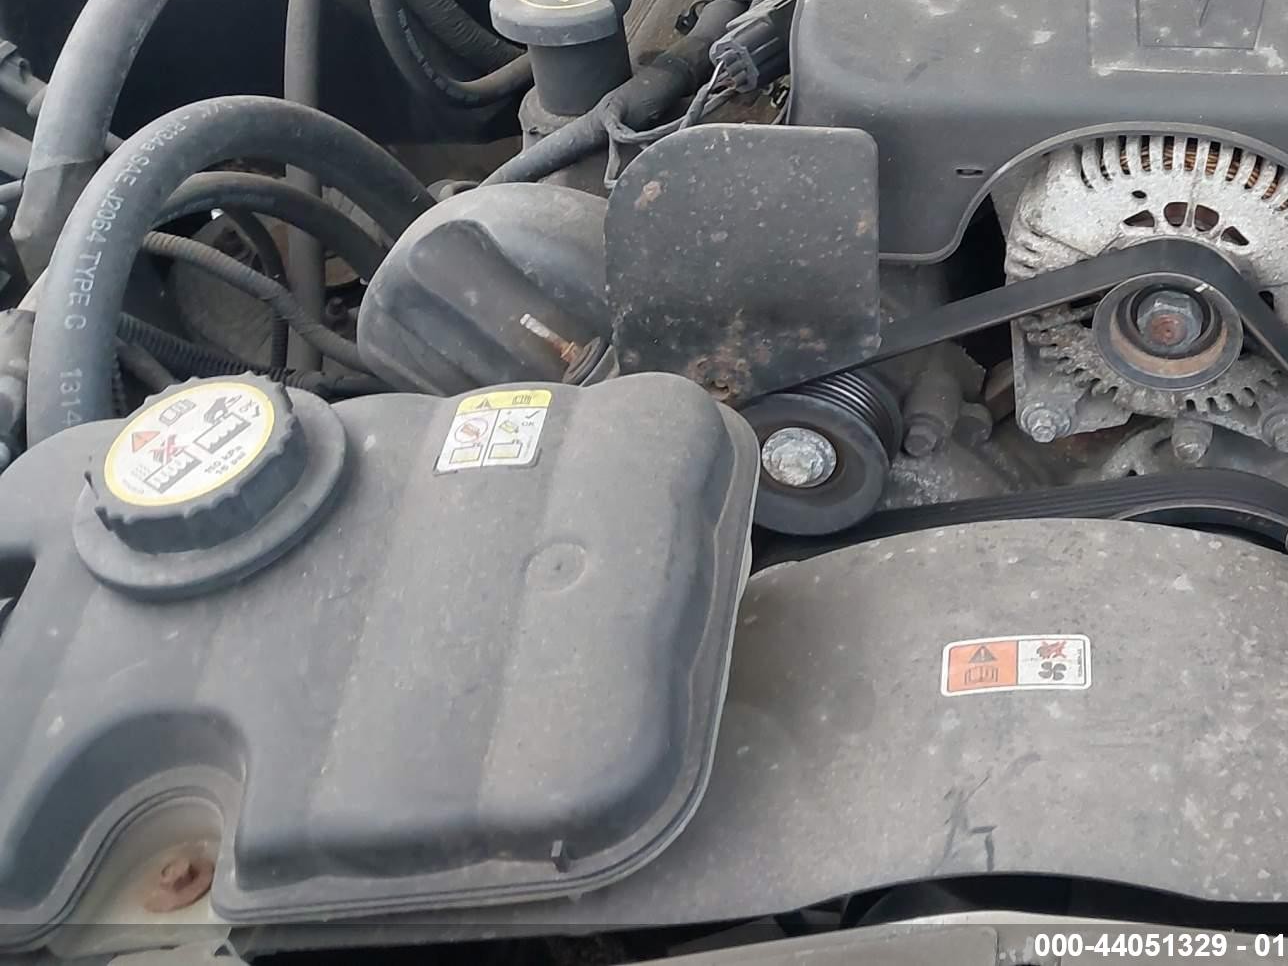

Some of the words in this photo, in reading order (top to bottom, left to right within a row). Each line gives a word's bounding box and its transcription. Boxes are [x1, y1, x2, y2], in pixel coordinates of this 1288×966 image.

[114, 154, 150, 186] SAE
[86, 188, 125, 243] J2064
[69, 251, 102, 307] TYPE
